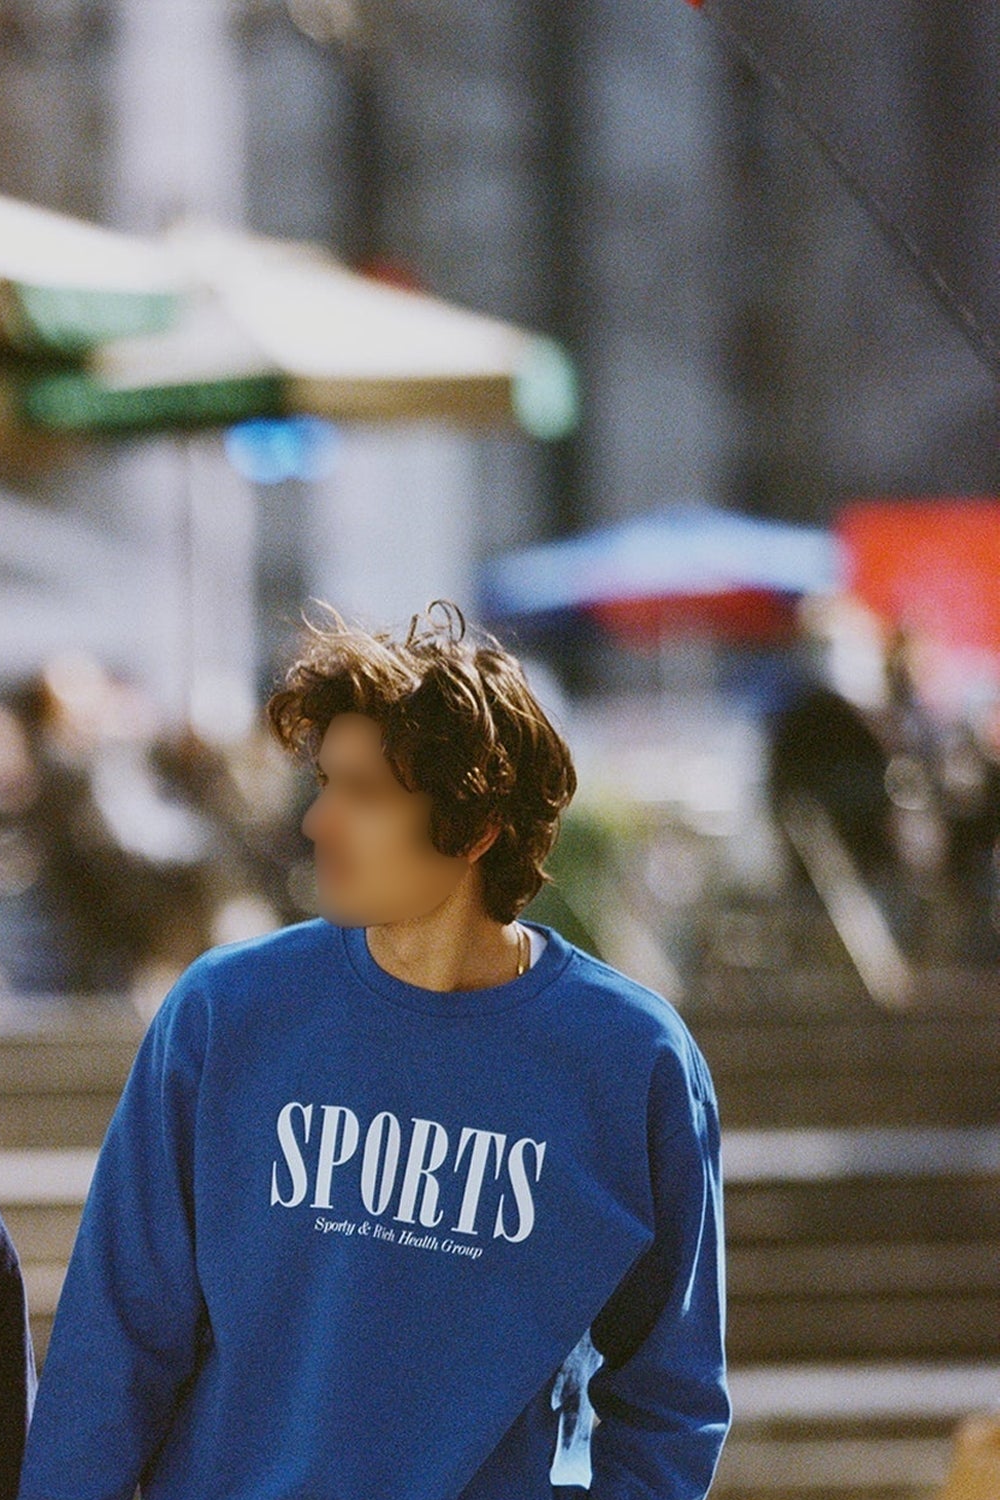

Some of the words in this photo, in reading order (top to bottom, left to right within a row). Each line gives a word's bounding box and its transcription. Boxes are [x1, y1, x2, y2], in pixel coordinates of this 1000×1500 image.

[270, 1101, 547, 1243] SPORTS
[314, 1217, 356, 1236] Sporty
[357, 1220, 371, 1236] &
[373, 1224, 396, 1242] Rich
[397, 1230, 439, 1250] Health
[440, 1238, 484, 1260] Group
